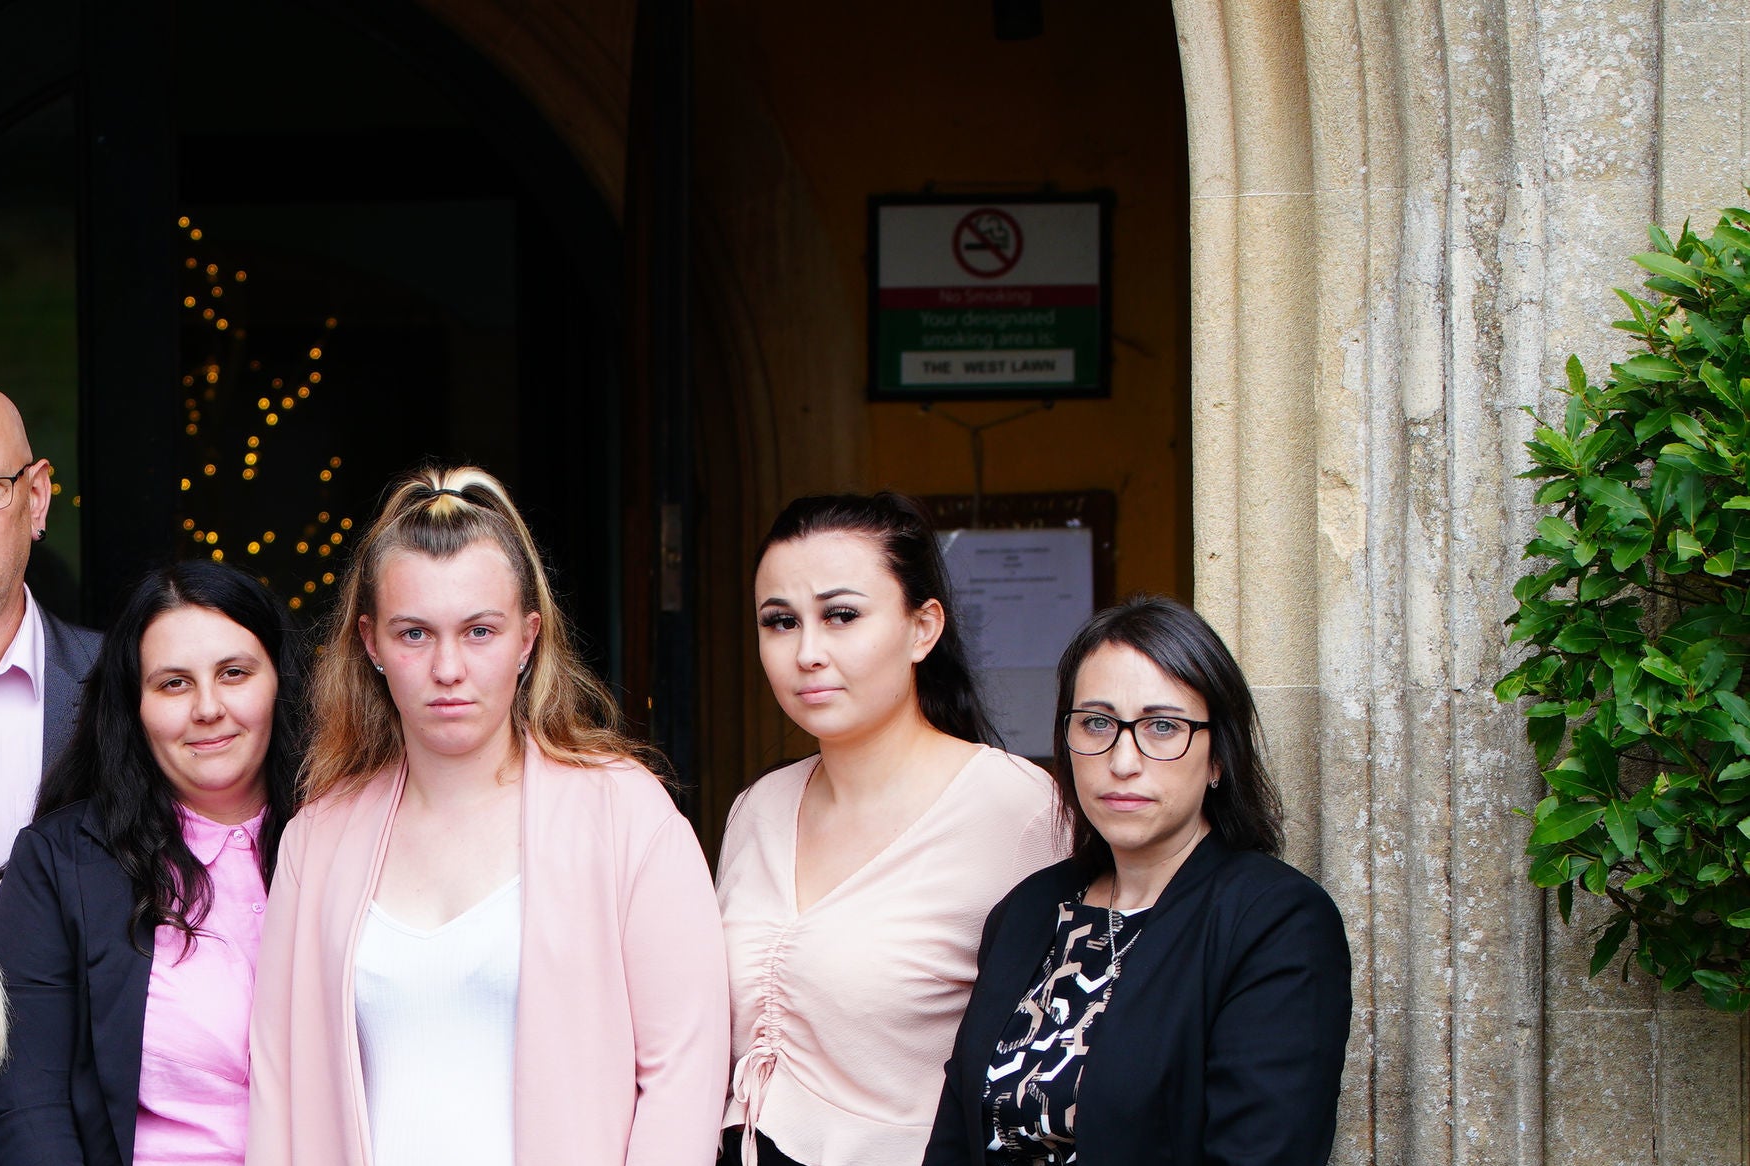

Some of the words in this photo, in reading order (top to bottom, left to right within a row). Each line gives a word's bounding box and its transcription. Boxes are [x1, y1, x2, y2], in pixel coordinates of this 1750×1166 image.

[938, 288, 962, 304] No
[964, 287, 1033, 307] Smoking
[921, 311, 957, 327] Your
[961, 308, 1057, 330] designated
[921, 331, 994, 350] smoking
[999, 332, 1034, 346] area
[923, 361, 951, 374] THE
[963, 361, 1006, 373] WEST
[1011, 360, 1056, 373] LAWN
